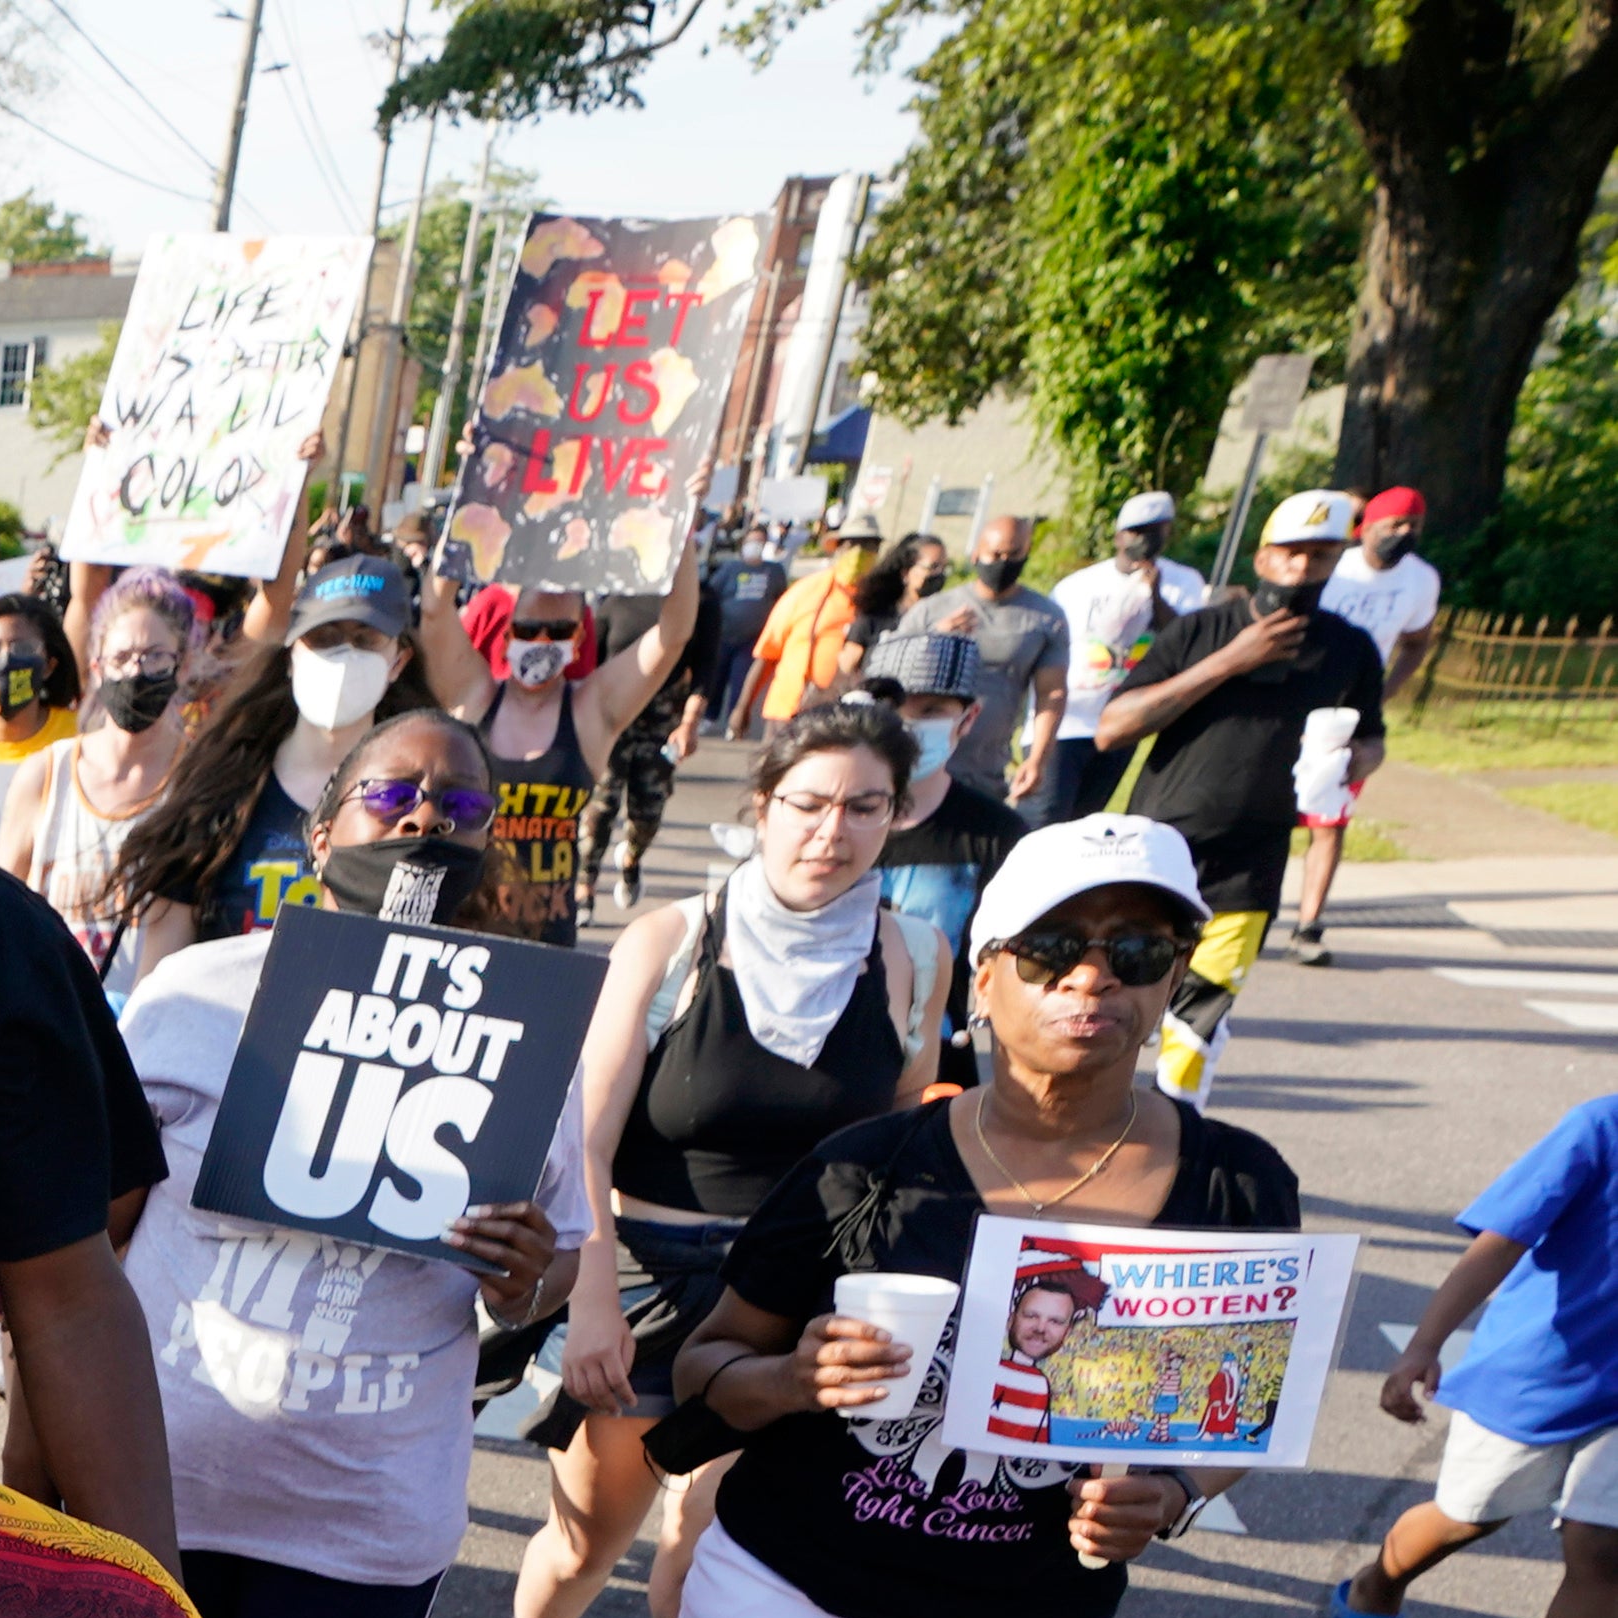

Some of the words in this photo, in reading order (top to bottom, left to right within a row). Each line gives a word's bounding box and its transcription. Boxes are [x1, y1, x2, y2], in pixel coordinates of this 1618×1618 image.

[577, 287, 704, 350] LET
[568, 360, 661, 427] US
[521, 428, 670, 496] LIVE
[371, 931, 491, 1009] IT'S
[302, 988, 525, 1082] ABOUT
[263, 1050, 494, 1241] US
[1111, 1256, 1300, 1290] WHERE'S
[1112, 1286, 1298, 1318] WOOTEN?
[159, 1301, 420, 1415] PEOPLE
[841, 1469, 916, 1530] Fight
